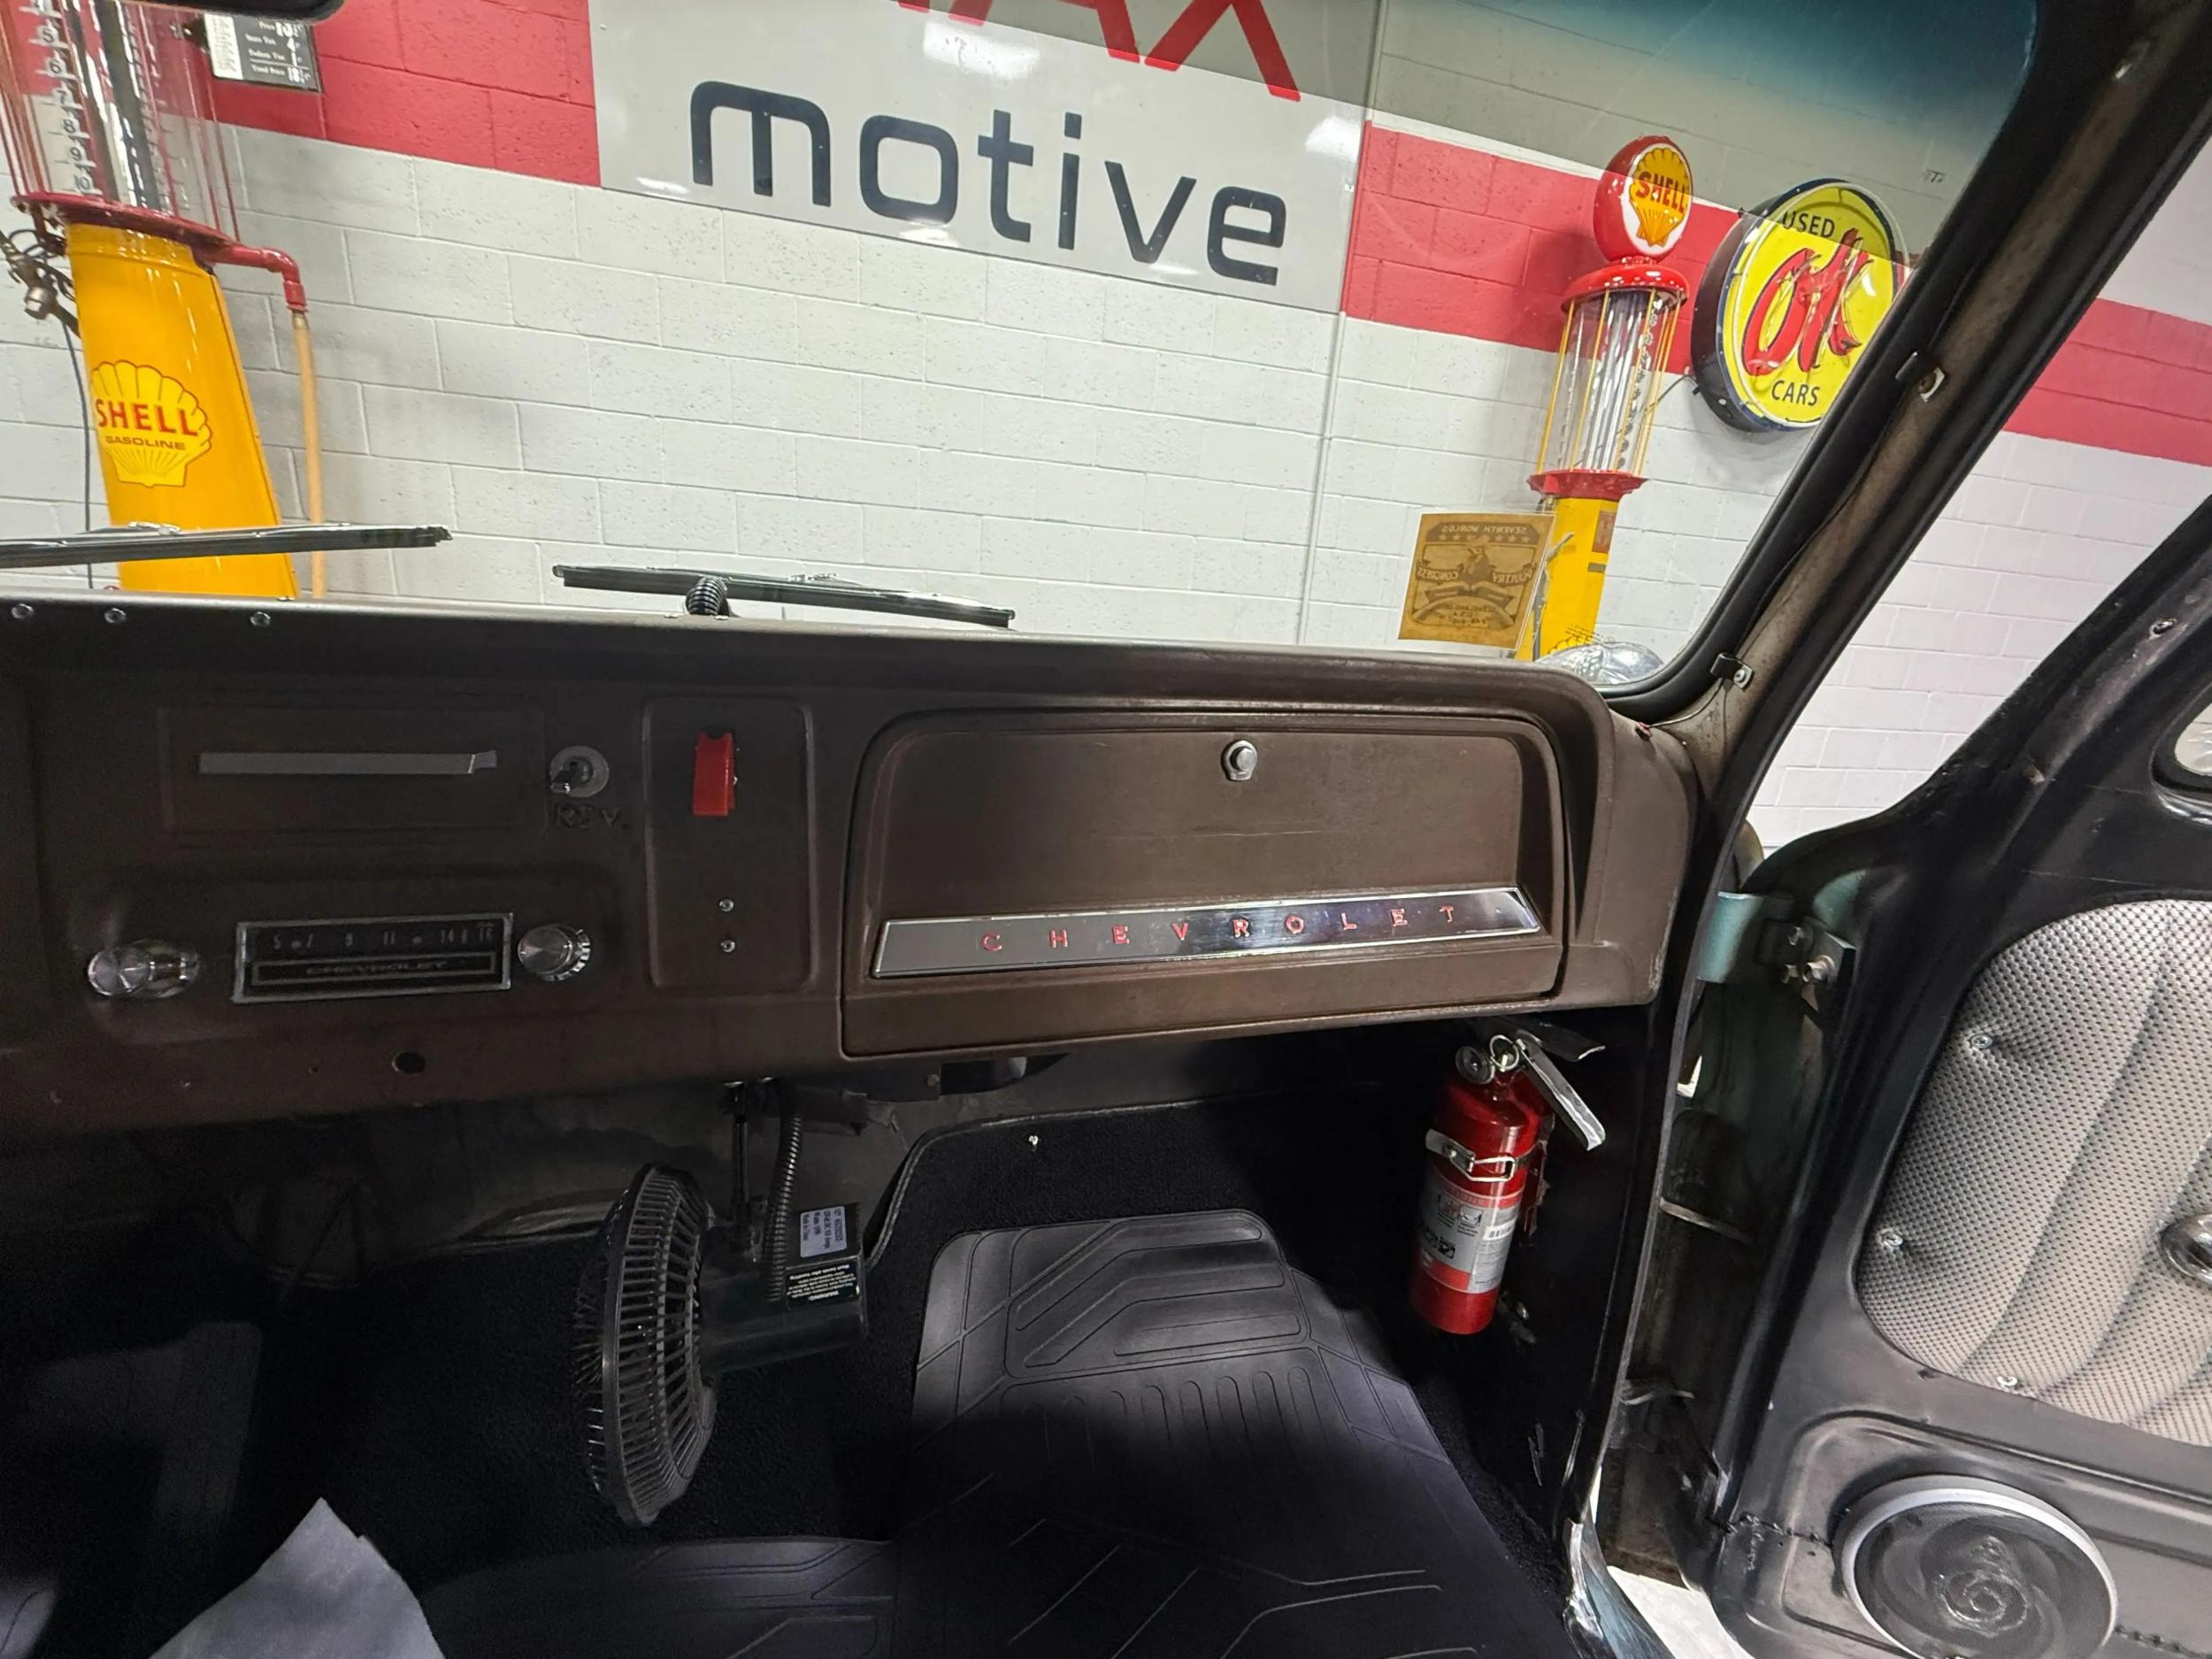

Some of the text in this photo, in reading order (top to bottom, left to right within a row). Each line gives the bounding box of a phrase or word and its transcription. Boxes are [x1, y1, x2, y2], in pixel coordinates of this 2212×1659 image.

[42, 27, 55, 43] 5
[49, 58, 62, 74] 6
[57, 88, 67, 105] 7
[63, 119, 76, 134] 8
[70, 146, 82, 162] 9
[73, 173, 91, 192] 10
[690, 81, 1286, 287] motive
[1635, 170, 1686, 214] SHELL
[1781, 209, 1836, 238] USED
[1742, 227, 1871, 376] OK
[1770, 380, 1821, 407] CARS
[95, 398, 199, 437] SHELL
[104, 434, 187, 451] GASOLINE
[981, 903, 1455, 953] CHEVROLET
